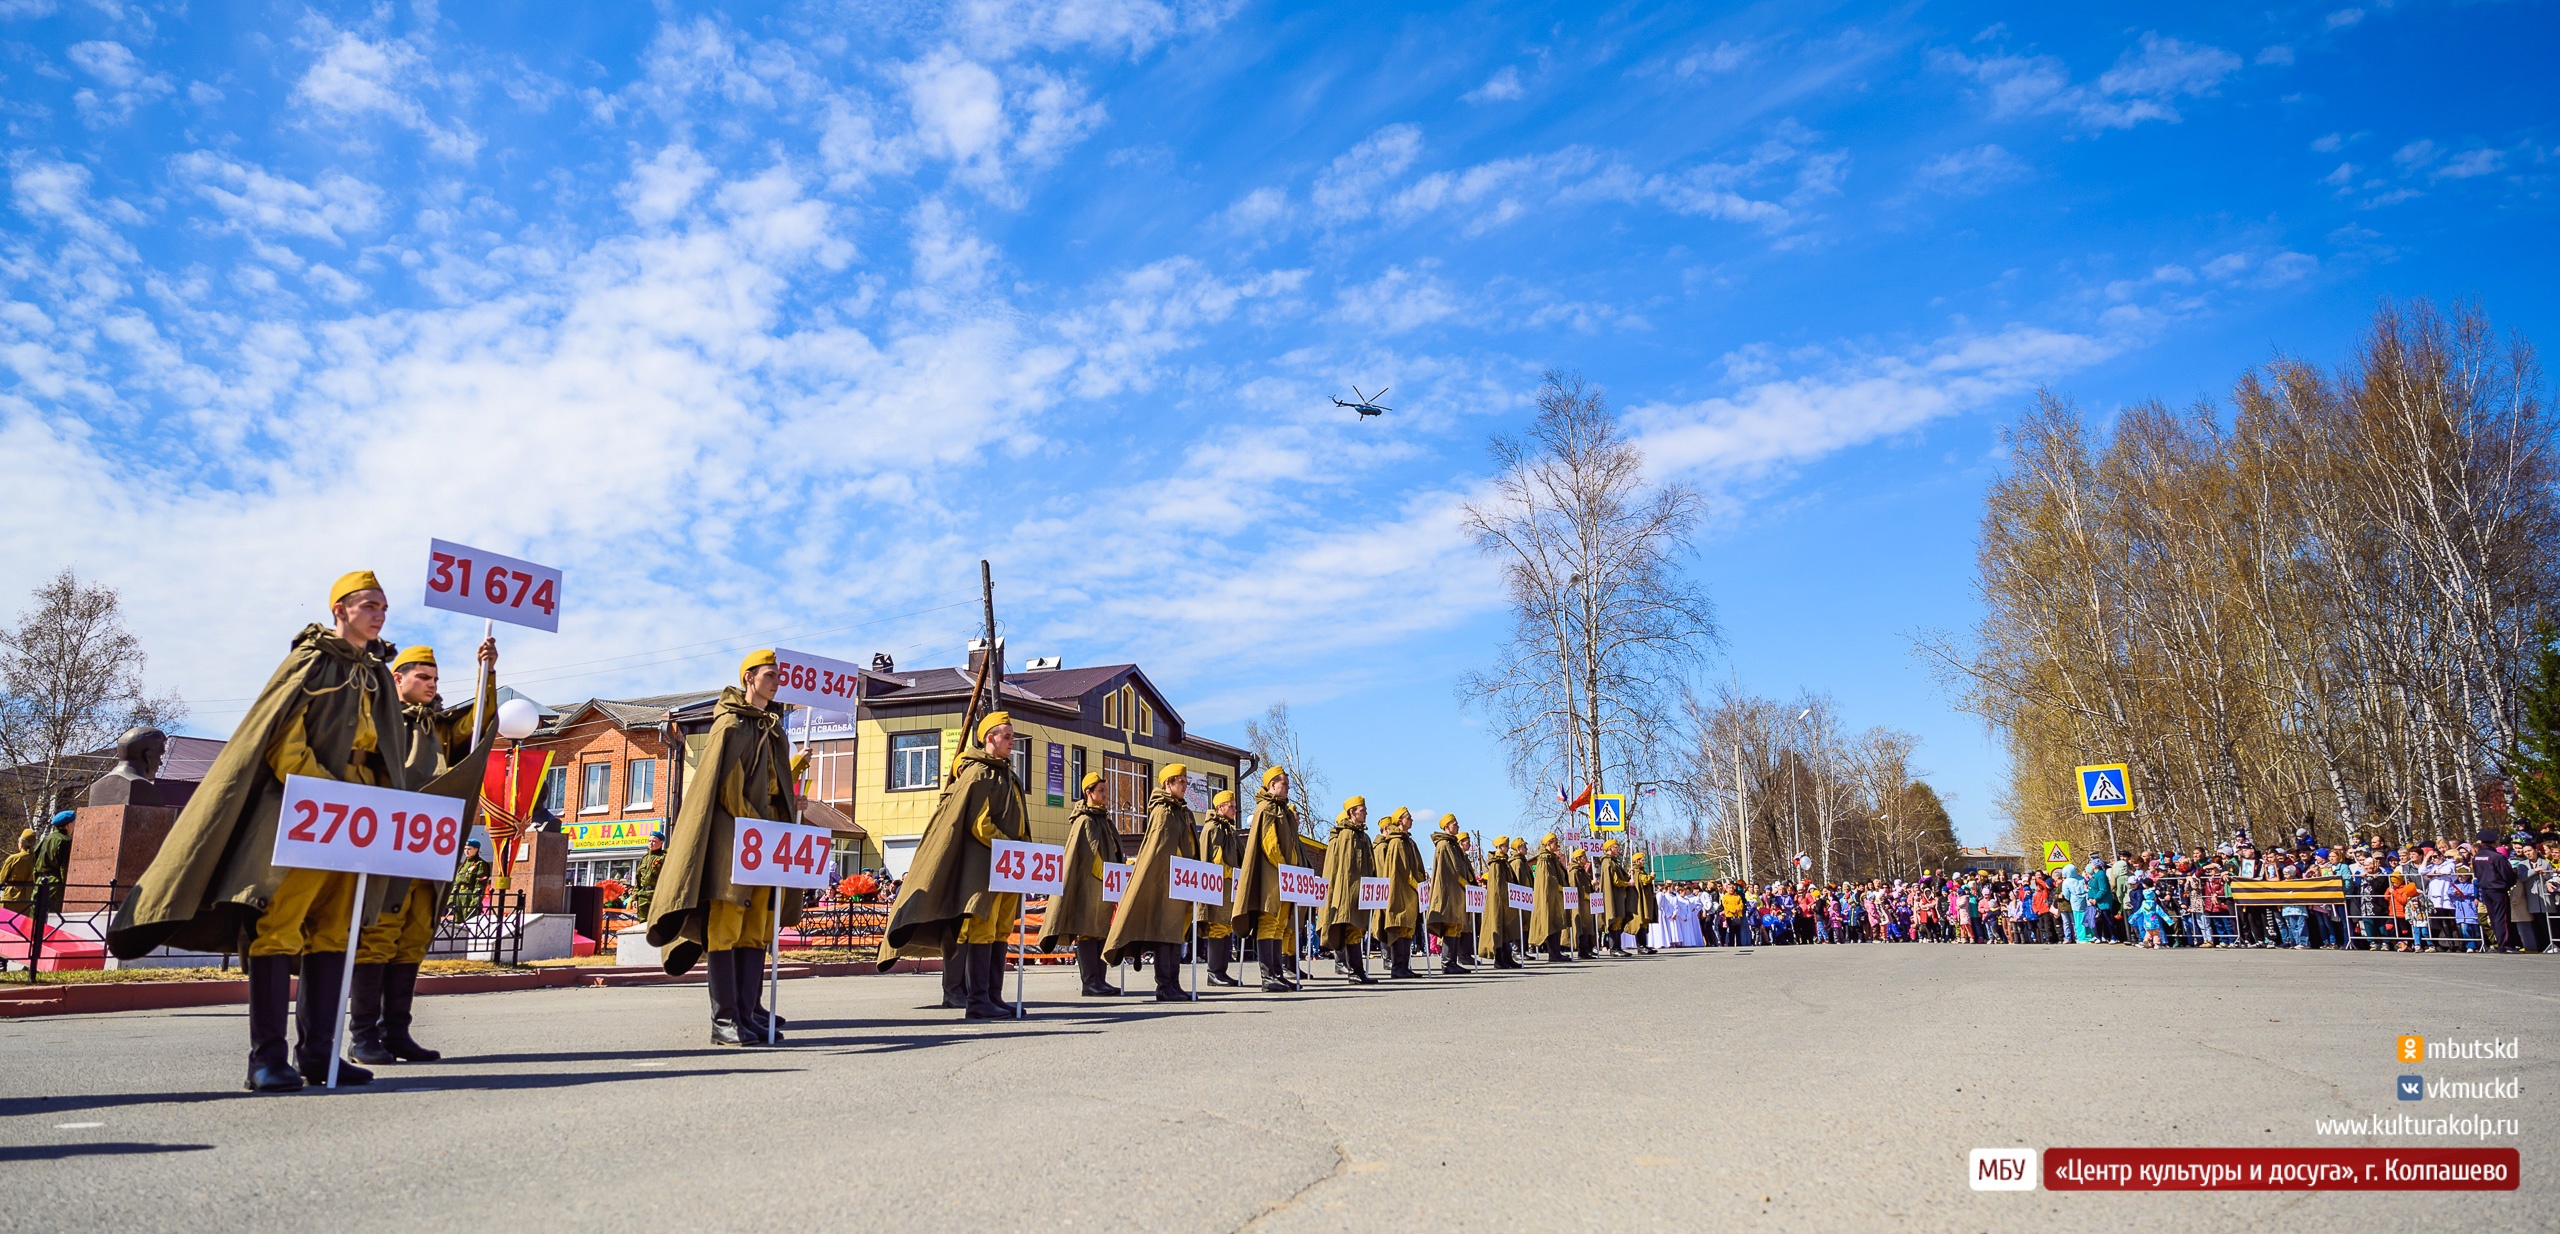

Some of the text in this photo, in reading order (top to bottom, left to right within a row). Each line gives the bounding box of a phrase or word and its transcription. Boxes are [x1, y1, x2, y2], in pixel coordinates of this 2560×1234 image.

[428, 551, 555, 616] 31 674
[778, 661, 858, 699] 568 347
[785, 723, 853, 736] МОДНЯ СВАДЬБА
[287, 799, 457, 856] 270 198
[560, 823, 655, 840] АРАНДАШ
[740, 828, 832, 875] 8 447
[995, 850, 1063, 883] 43 251
[1104, 870, 1121, 892] 41
[1174, 868, 1224, 893] 344 000
[1281, 872, 1315, 895] 32 899
[1362, 883, 1389, 902] 131 910
[1509, 889, 1533, 904] 273 500
